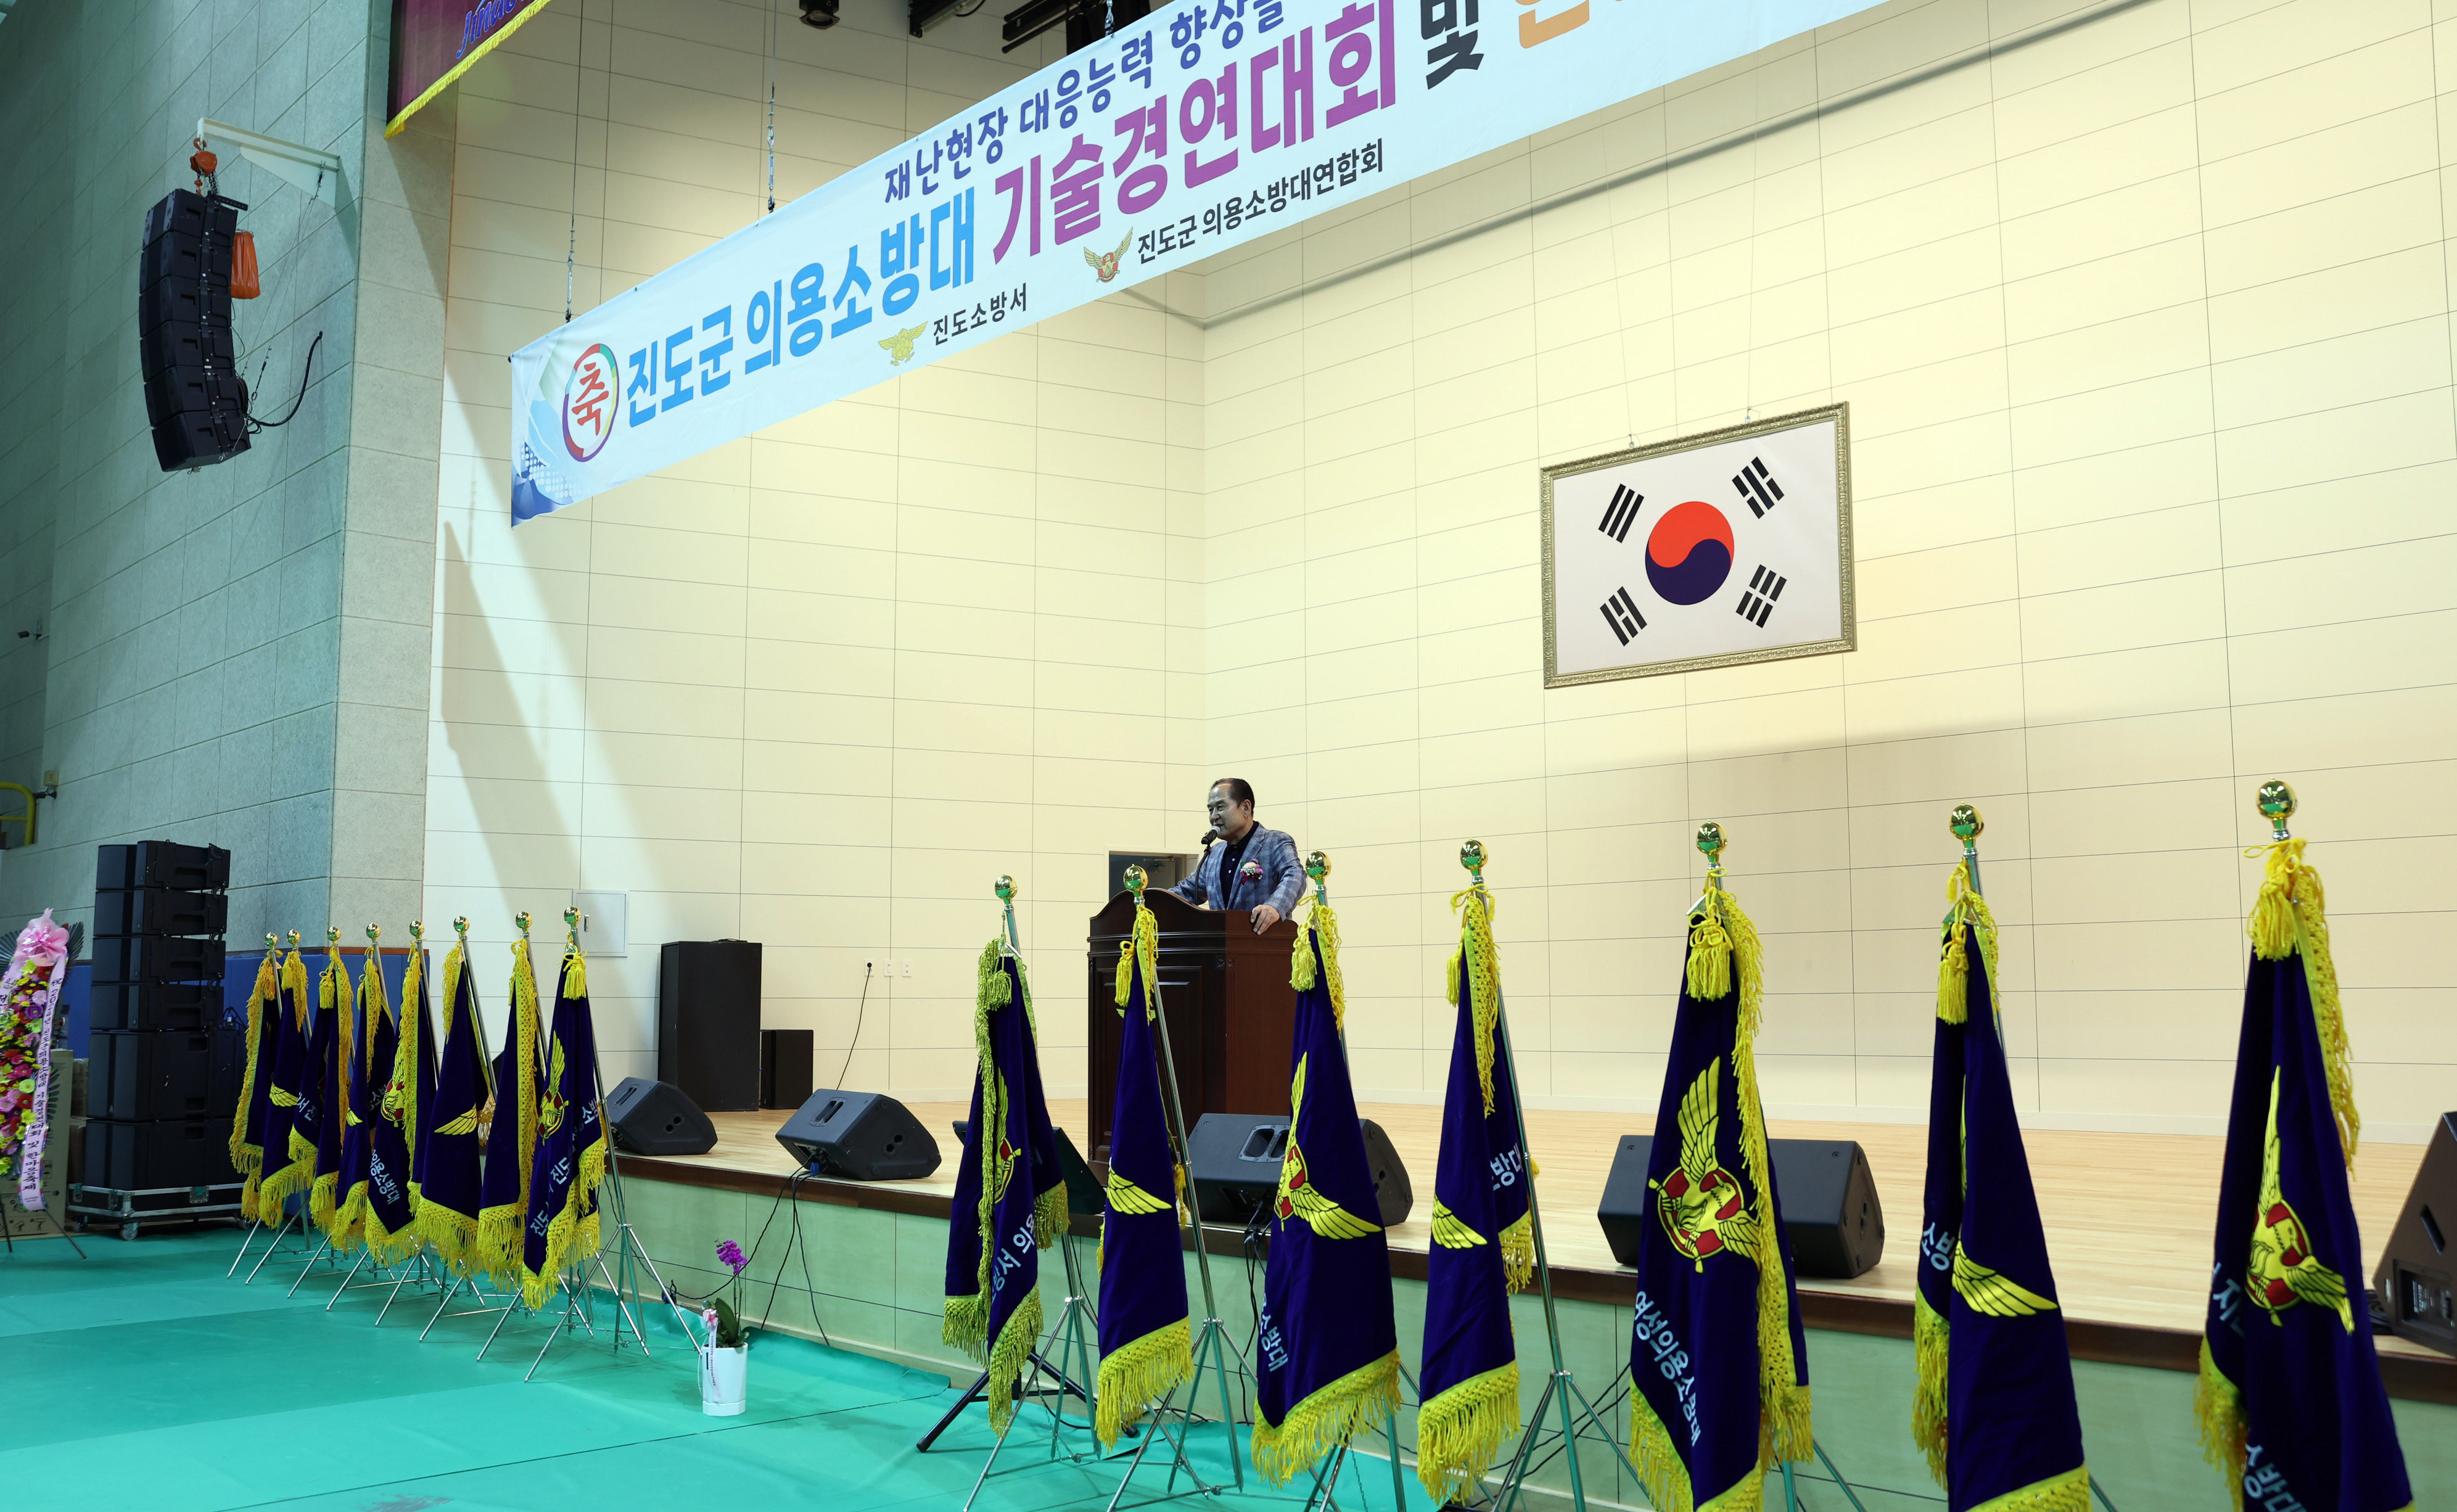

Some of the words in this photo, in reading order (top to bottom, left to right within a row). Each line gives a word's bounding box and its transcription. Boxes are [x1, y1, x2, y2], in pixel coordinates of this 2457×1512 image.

[885, 106, 1008, 203] 재난현장
[1019, 30, 1153, 133] 대응능력
[1170, 0, 1284, 70] 향상을
[627, 305, 734, 429] 진도군
[745, 186, 974, 375] 의용소방대
[991, 0, 1396, 265] 기술경연대회
[1137, 215, 1198, 265] 진도군
[1203, 138, 1383, 236] 의용소방대연합회
[932, 255, 1027, 346] 진도소방서
[572, 362, 609, 437] 축
[22, 1151, 41, 1191] 한마음축제
[370, 1149, 400, 1206] 의용소방대
[1259, 1292, 1289, 1373] 소방대
[1634, 1291, 1701, 1447] 여성의용소방대
